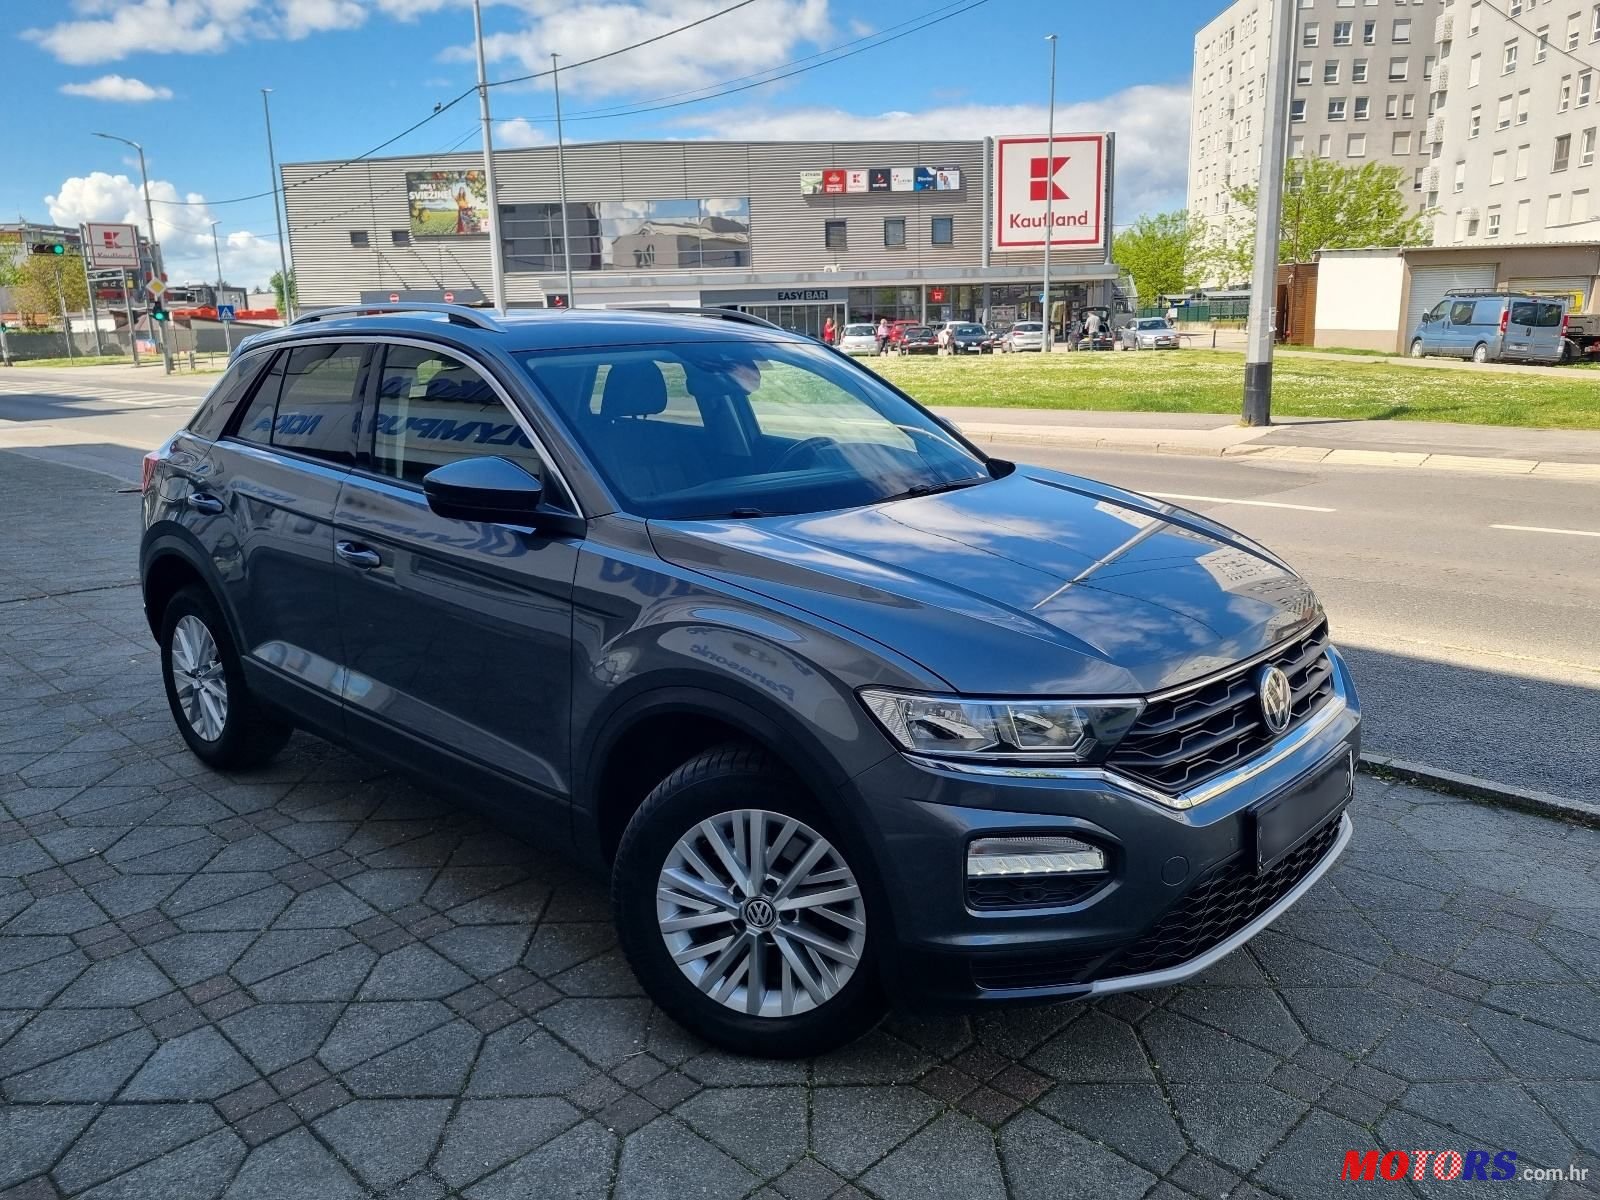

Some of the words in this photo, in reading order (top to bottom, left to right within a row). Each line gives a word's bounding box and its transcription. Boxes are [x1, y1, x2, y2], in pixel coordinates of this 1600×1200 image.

[1010, 210, 1088, 229] Kaufland
[778, 291, 802, 300] EASY
[805, 290, 827, 300] BAR
